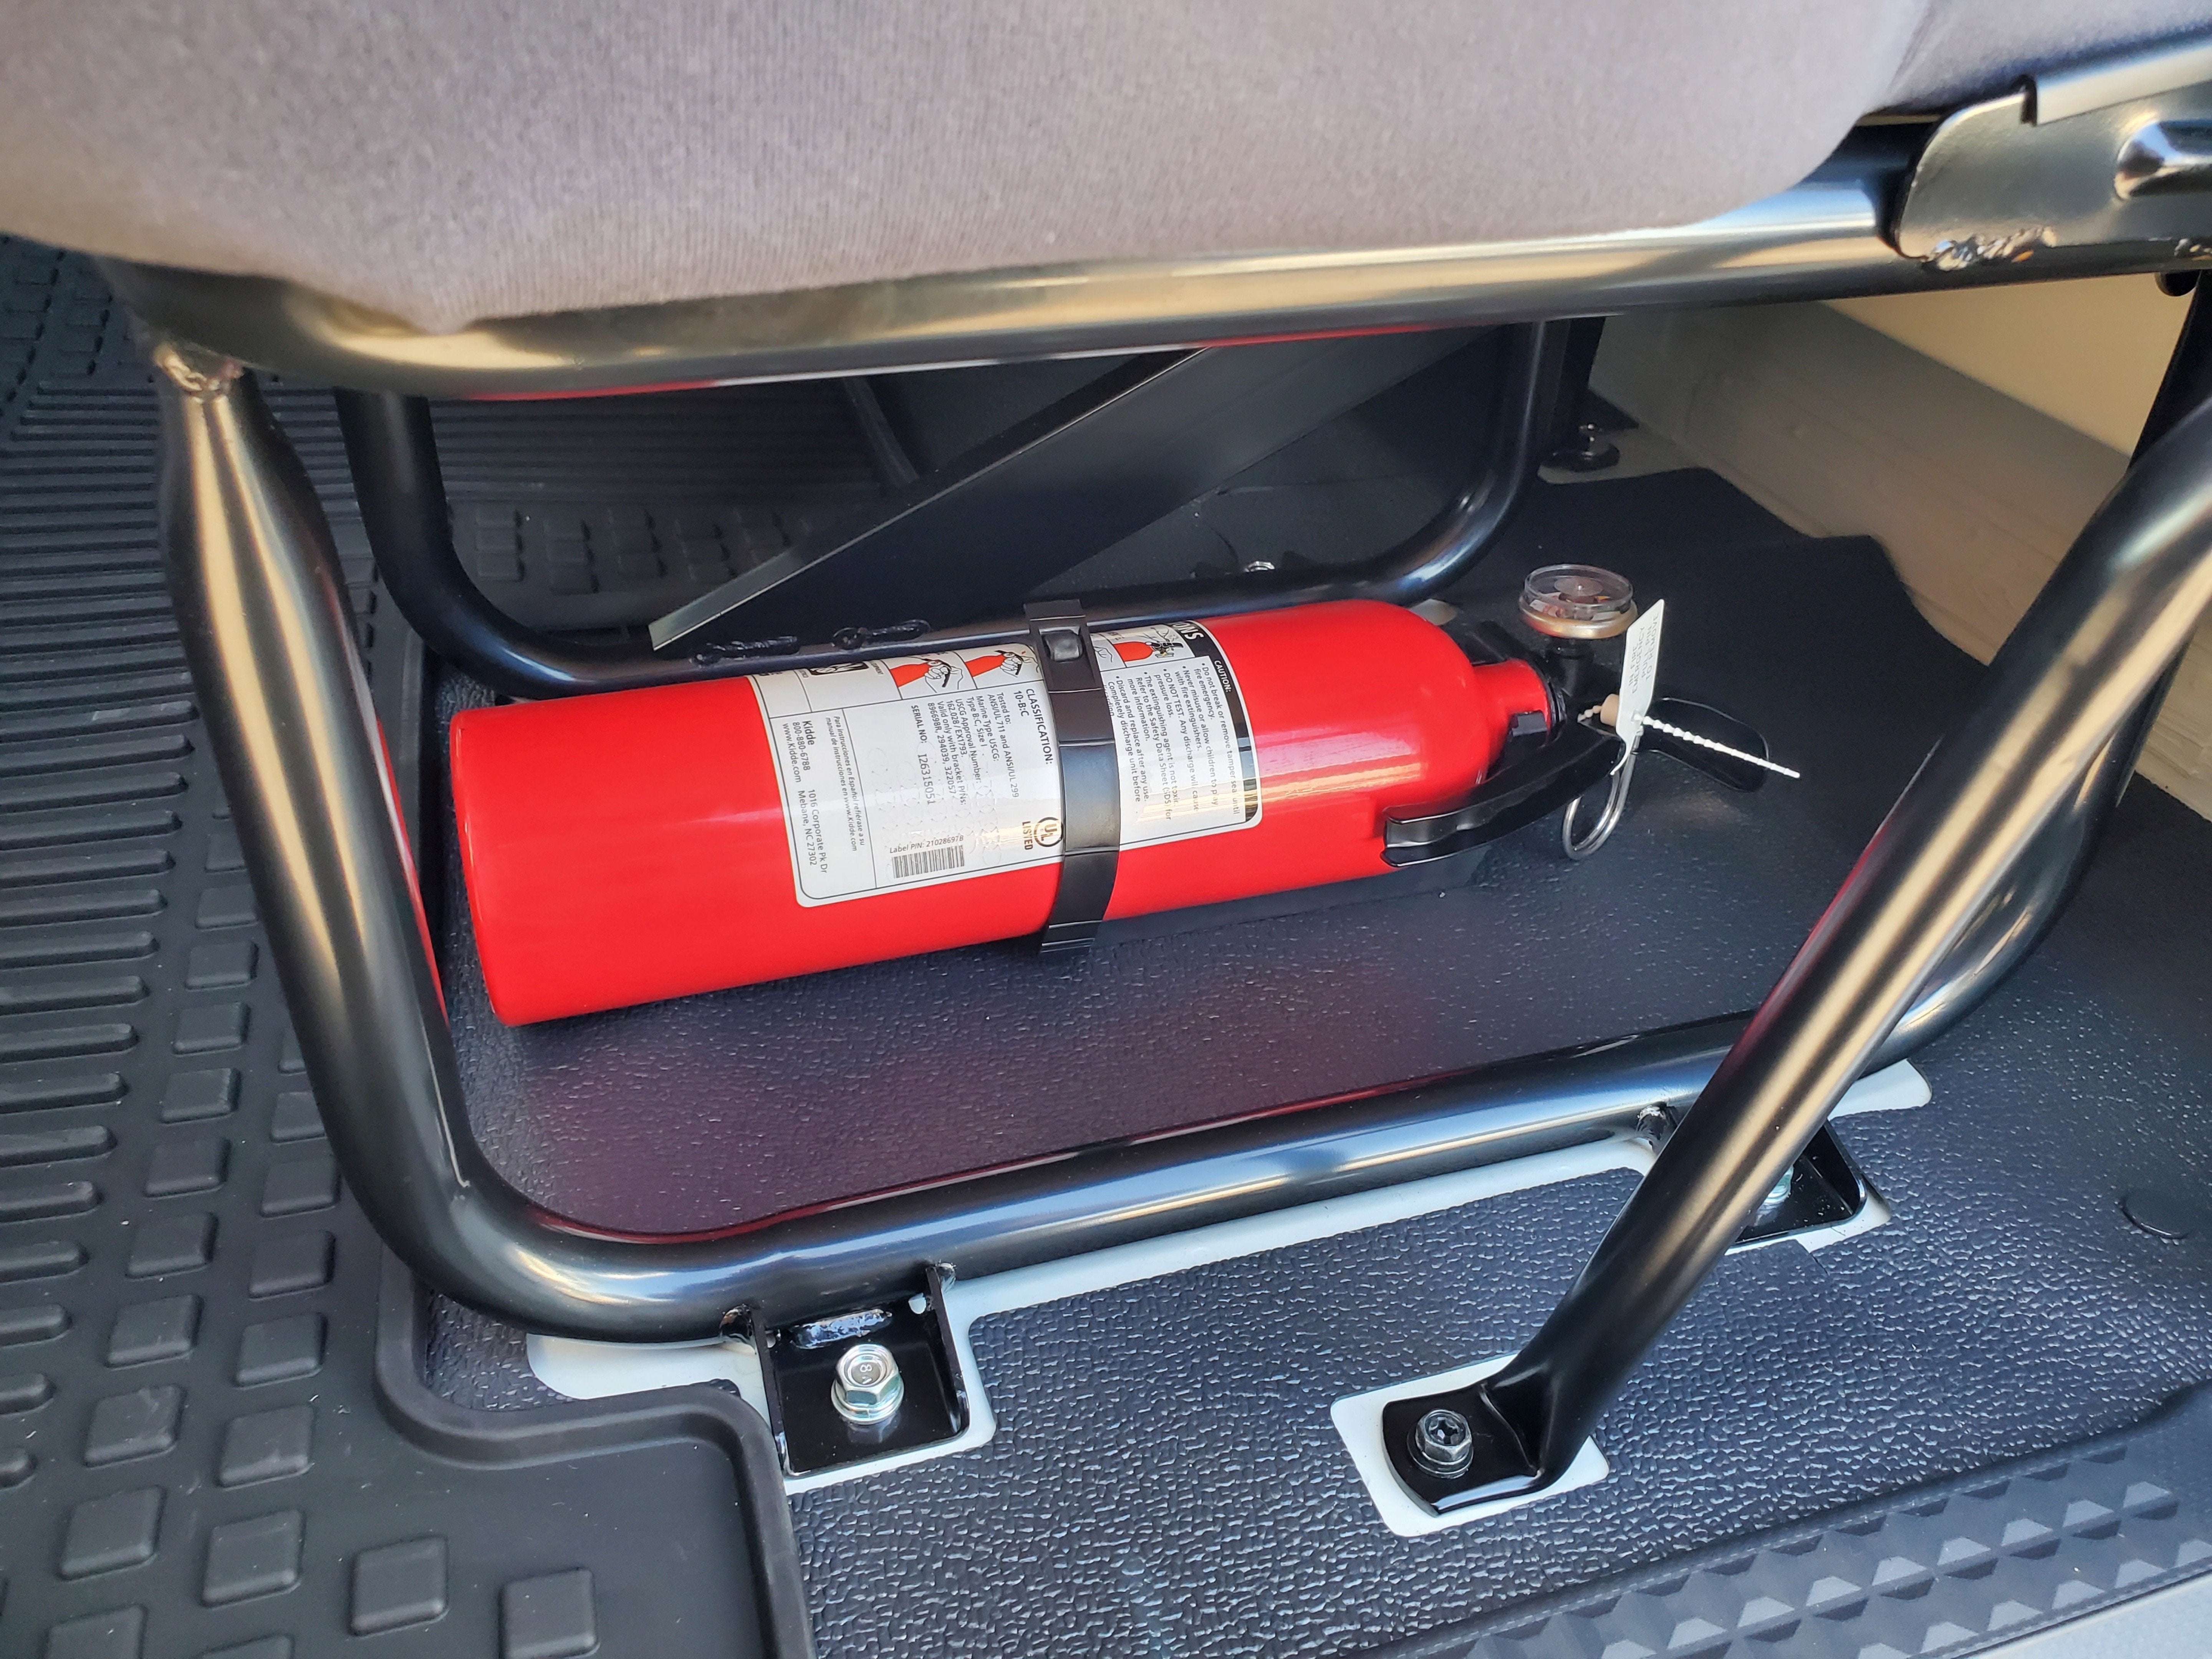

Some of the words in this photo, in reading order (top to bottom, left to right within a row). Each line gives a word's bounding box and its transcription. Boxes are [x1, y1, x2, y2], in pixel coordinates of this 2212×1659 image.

[1630, 644, 1639, 669] FIRE
[1646, 665, 1652, 681] TO
[1649, 613, 1659, 659] REMOVE
[1202, 667, 1210, 676] Do
[1632, 626, 1646, 694] EMERGENCY
[1135, 677, 1147, 694] Refer
[1183, 670, 1195, 688] Never
[1206, 677, 1215, 689] not
[1214, 660, 1232, 692] CAUTION:
[1629, 674, 1634, 686] IN
[966, 696, 977, 712] Type
[996, 692, 1010, 714] Tested
[1013, 690, 1030, 717] 10-B:C
[1108, 681, 1125, 719] Completely
[1116, 680, 1131, 704] Discard
[1153, 674, 1169, 701] pressure
[1166, 702, 1174, 718] loss.
[1190, 689, 1202, 712] misuse
[1194, 668, 1202, 679] fire
[1199, 680, 1215, 720] emergency.
[1211, 689, 1223, 709] break
[937, 700, 949, 717] Valid
[955, 699, 967, 716] USCG
[987, 694, 1002, 720] ANSI/UL
[1125, 705, 1135, 718] and
[1127, 679, 1137, 695] more
[1134, 696, 1150, 741] information.
[1145, 704, 1153, 716] the
[1174, 671, 1185, 685] with
[1181, 686, 1189, 698] fire
[1185, 700, 1202, 751] extinguishers.
[1198, 714, 1205, 722] or
[1218, 711, 1224, 719] or
[825, 717, 837, 737] manual
[833, 716, 841, 728] Para
[911, 705, 924, 729] SERIAL
[918, 729, 927, 743] NO:
[942, 719, 952, 734] only
[946, 700, 960, 725] 162.028
[955, 729, 968, 757] EX1793.
[972, 713, 982, 726] B:C,
[976, 696, 988, 719] Marine
[983, 719, 993, 737] Type
[989, 738, 1000, 762] USCG:
[996, 720, 1005, 732] 711
[1026, 689, 1053, 764] CLASSIFICATION:
[1144, 675, 1153, 687] The
[1149, 689, 1167, 736] extinguishing
[1163, 738, 1173, 761] agent
[1169, 770, 1177, 784] not
[1149, 717, 1160, 741] Safety
[1163, 673, 1173, 683] DO
[1168, 684, 1179, 698] NOT
[1174, 699, 1184, 718] TEST.
[1179, 720, 1187, 734] Any
[1183, 736, 1195, 773] discharge
[802, 720, 816, 745] Kidde
[947, 735, 957, 753] with
[960, 717, 976, 749] Approval
[976, 728, 985, 742] Size
[1000, 735, 1010, 749] and
[1120, 720, 1133, 756] discharge
[1129, 720, 1141, 747] replace
[1201, 724, 1209, 744] allow
[1220, 720, 1230, 748] remove
[782, 723, 801, 783] www.Kidde.com
[792, 722, 811, 771] 800-880-6788
[837, 729, 851, 766] instrucciones
[927, 702, 942, 733] 896698R,
[937, 735, 950, 764] 294039,
[944, 766, 957, 794] 322057
[1136, 749, 1145, 768] after
[1156, 743, 1164, 761] Data
[833, 747, 846, 786] instrucciones
[846, 767, 853, 775] en
[951, 754, 963, 783] bracket
[969, 750, 982, 783] Number:
[1003, 751, 1016, 782] ANSI/UL
[1129, 758, 1137, 774] unit
[1205, 746, 1215, 777] children
[1227, 750, 1236, 778] tamper
[1159, 763, 1169, 786] Sheet
[1211, 779, 1217, 788] to
[808, 789, 818, 807] 1016
[842, 788, 848, 796] en
[848, 777, 859, 801] Español
[1010, 783, 1019, 798] 299
[1132, 775, 1141, 802] before
[1210, 789, 1219, 805] pay
[798, 790, 809, 826] Mebane,
[805, 828, 813, 840] NC
[812, 809, 824, 850] Corporate
[844, 797, 857, 851] www.Kidde.com
[1022, 821, 1033, 850] LISTED
[807, 842, 817, 866] 27302
[818, 852, 827, 862] Pk
[890, 844, 909, 853] Label
[820, 863, 828, 873] Dr
